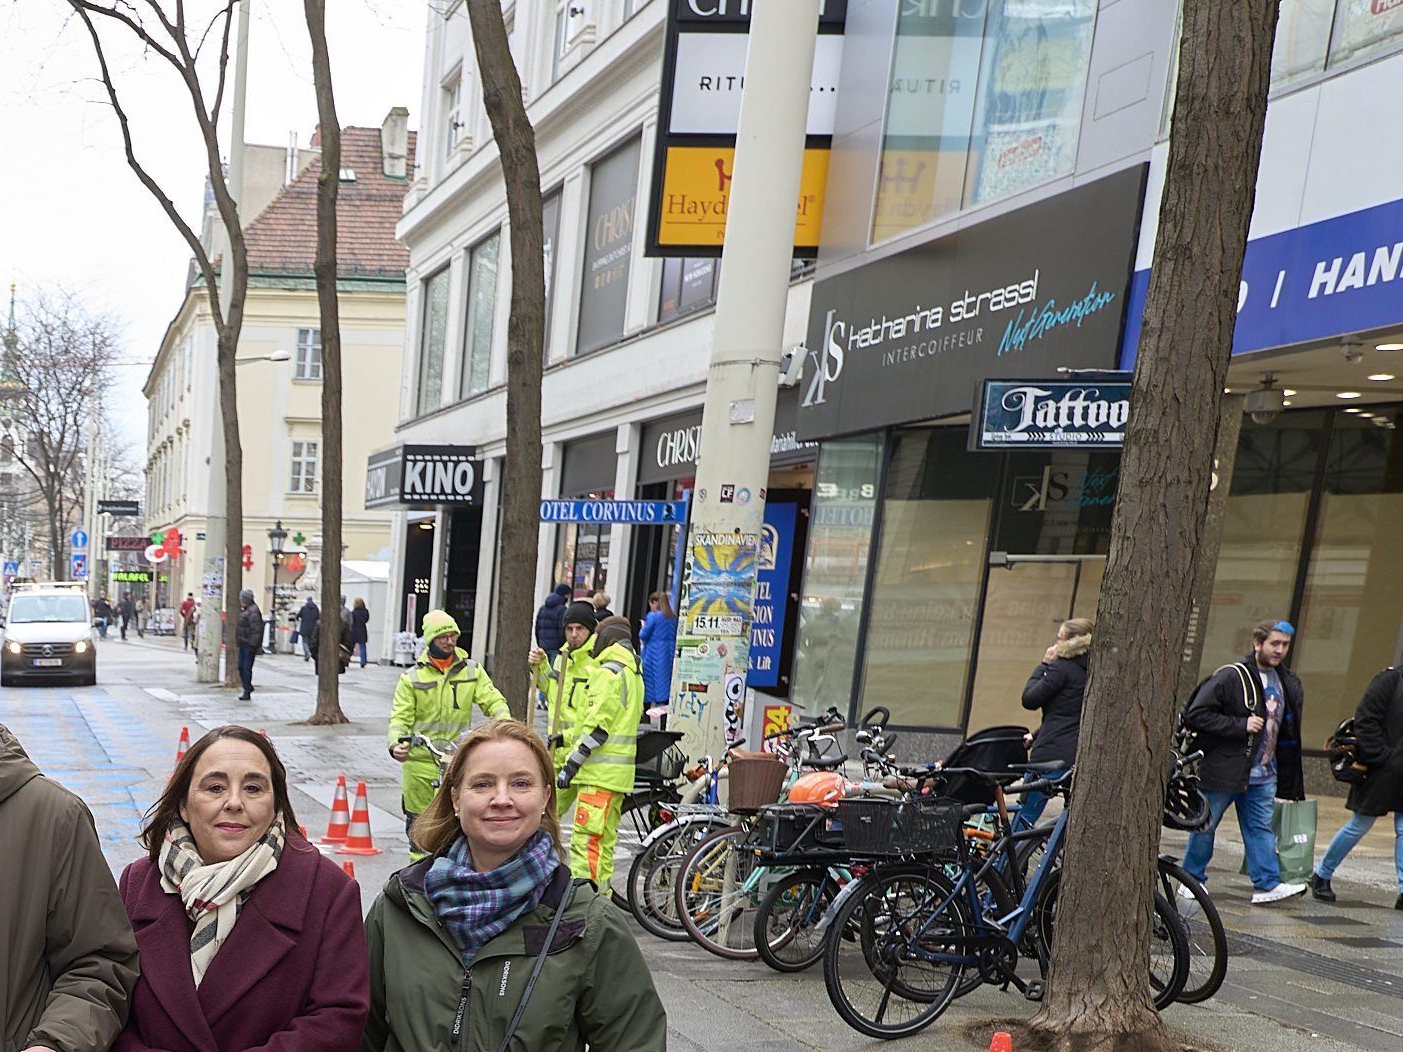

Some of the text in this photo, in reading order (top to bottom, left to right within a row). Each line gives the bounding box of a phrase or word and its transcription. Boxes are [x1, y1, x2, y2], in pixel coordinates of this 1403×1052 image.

[666, 194, 727, 223] Hayd
[1307, 241, 1403, 299] HAN
[949, 268, 1039, 323] strassl
[882, 327, 984, 367] INTERCOIFFEUR
[1001, 387, 1130, 432] Tattoo
[404, 461, 474, 495] KINO
[540, 501, 655, 522] OTEL CORVINUS
[110, 539, 147, 549] PIZZA
[696, 533, 758, 547] SKANDINAVIEN
[499, 960, 511, 997] DIDRIKSONS
[453, 997, 467, 1035] DIDRIKSONS
